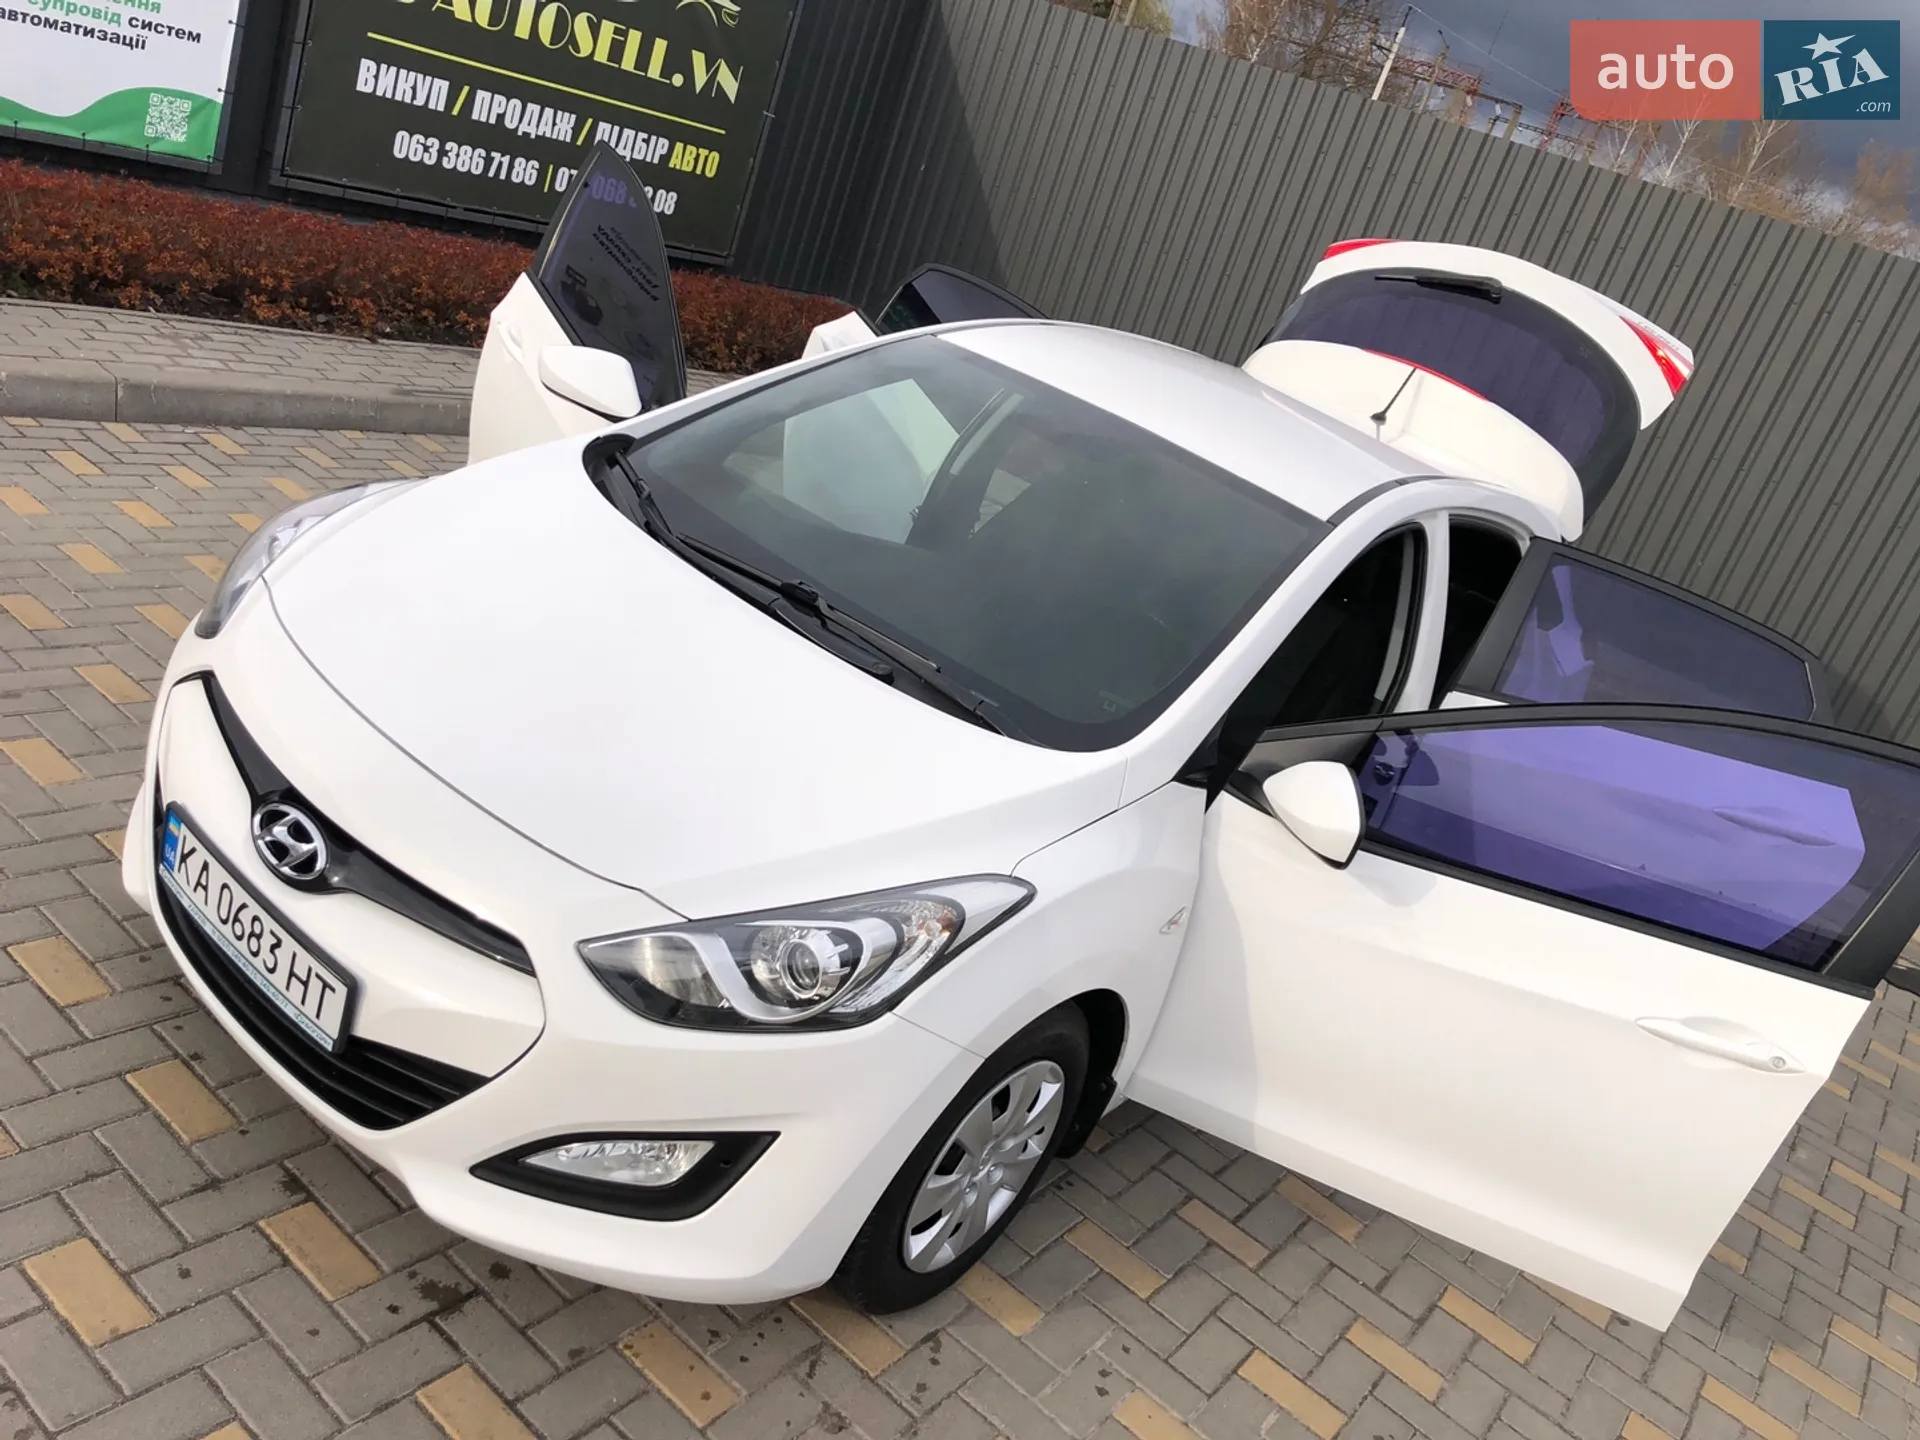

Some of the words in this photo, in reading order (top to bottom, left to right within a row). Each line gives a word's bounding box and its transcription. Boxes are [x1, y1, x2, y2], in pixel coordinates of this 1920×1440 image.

[0, 7, 148, 50] автоматизації
[128, 16, 202, 43] систем
[356, 58, 450, 112] ВИКУП
[471, 89, 577, 142] ПРОДАЖ
[594, 121, 670, 164] ПІДБІР
[668, 141, 720, 178] АВТО
[393, 130, 440, 166] 063
[442, 141, 486, 175] 386
[177, 834, 210, 907] KA
[217, 882, 282, 975] 0683
[286, 951, 336, 1021] HT
